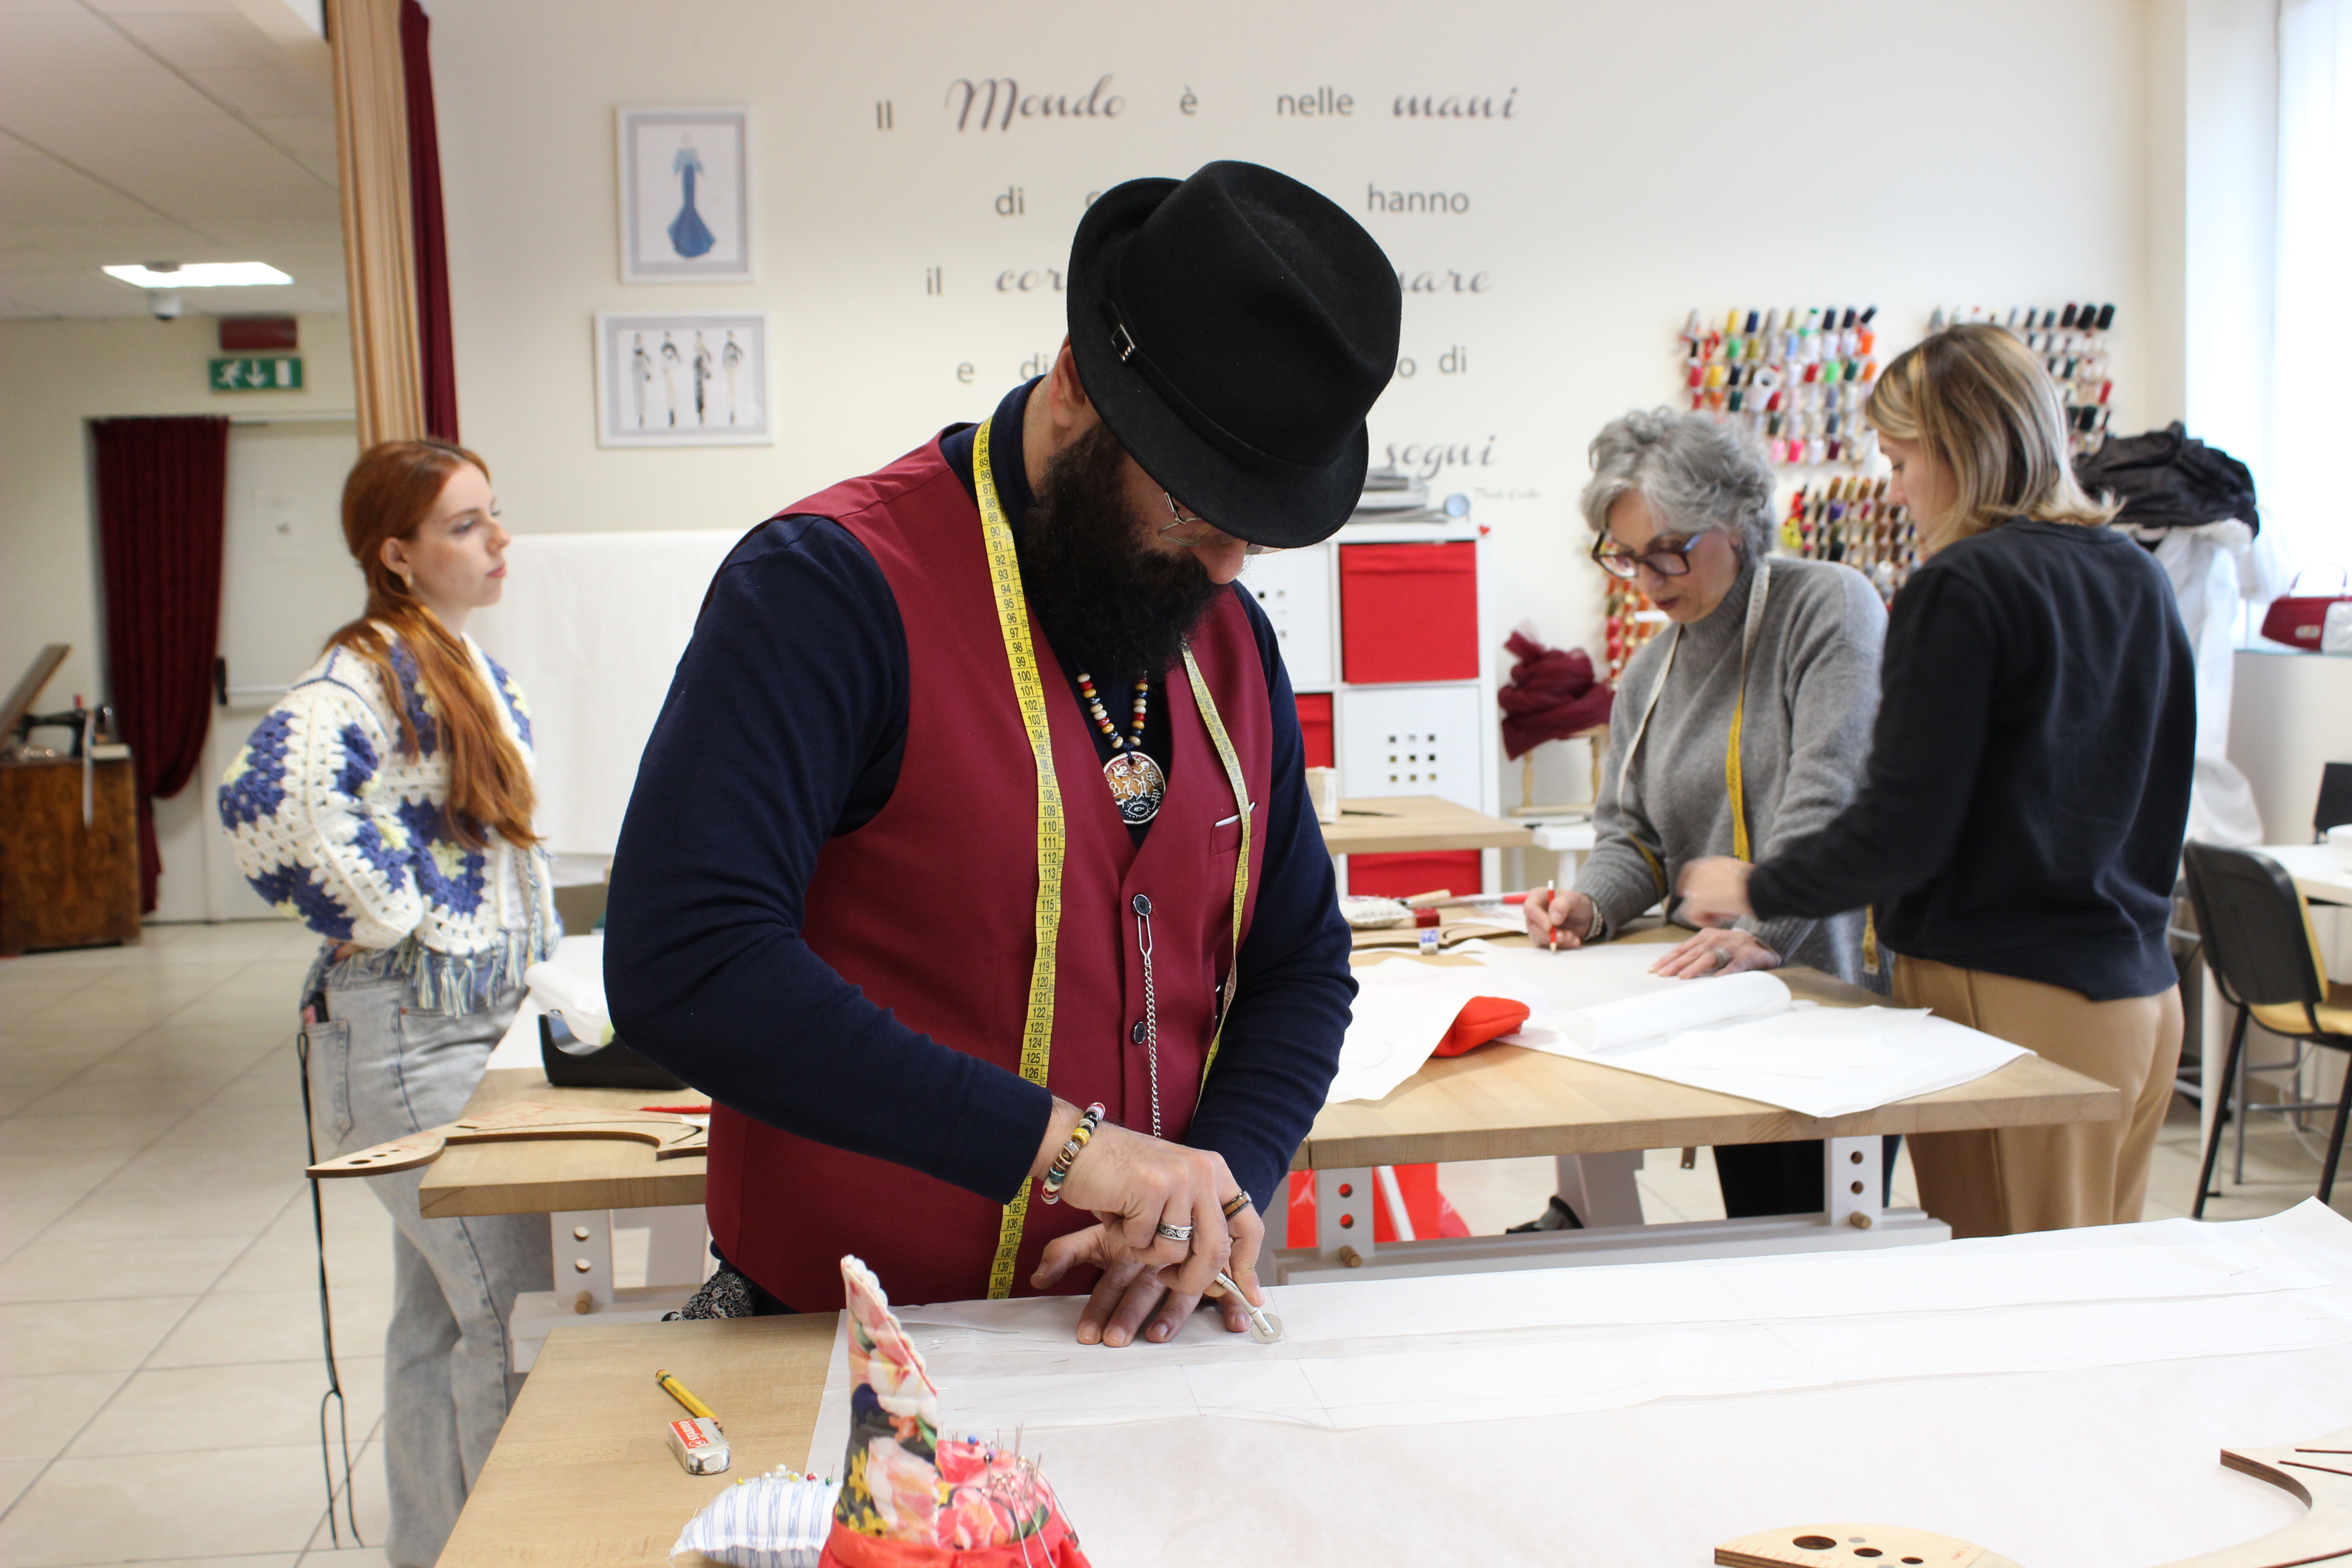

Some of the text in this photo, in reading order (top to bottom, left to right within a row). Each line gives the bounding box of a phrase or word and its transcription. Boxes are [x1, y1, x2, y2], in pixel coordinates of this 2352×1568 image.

[876, 73, 1518, 132] Il Mondo è nelle mani
[995, 181, 1470, 216] di hanno
[926, 266, 942, 295] il
[956, 362, 974, 383] e
[1439, 344, 1466, 374] di
[979, 436, 987, 445] 83
[979, 446, 987, 456] 84
[979, 457, 989, 467] 85
[1386, 433, 1496, 481] sogni
[980, 470, 990, 480] 86
[983, 483, 992, 494] 87
[985, 498, 995, 508] 88
[988, 512, 998, 522] 89
[990, 526, 1000, 537] 90
[993, 541, 1002, 551] 91
[995, 554, 1006, 565] 92
[1011, 559, 1017, 569] 46
[998, 569, 1009, 580] 93
[1001, 584, 1011, 594] 94
[1017, 589, 1023, 598] 47
[1004, 598, 1014, 609] 95
[1006, 613, 1017, 623] 96
[1022, 619, 1028, 628] 48
[1009, 627, 1019, 638] 97
[1013, 642, 1023, 652] 98
[1028, 649, 1034, 658] 49
[1016, 657, 1026, 667] 99
[1017, 671, 1031, 681] 100
[1034, 677, 1041, 686] 50
[1020, 685, 1034, 696] 101
[1024, 700, 1038, 710] 102
[1028, 715, 1041, 725] 103
[1032, 730, 1044, 740] 104
[1036, 744, 1046, 755] 105
[1039, 759, 1049, 770] 106
[1041, 774, 1051, 785] 107
[1043, 789, 1054, 800] 108
[1056, 797, 1062, 807] 54
[1043, 805, 1055, 816] 109
[1043, 821, 1057, 832] 110
[1059, 828, 1065, 838] 55
[1043, 837, 1056, 848] 111
[1043, 852, 1056, 863] 112
[1058, 860, 1063, 870] 56
[1044, 868, 1055, 879] 113
[1043, 883, 1054, 895] 114
[1042, 899, 1054, 910] 115
[1041, 915, 1053, 926] 116
[1041, 930, 1052, 941] 117
[1041, 946, 1050, 957] 118
[1039, 961, 1049, 972] 119
[1037, 976, 1049, 988] 120
[1049, 984, 1054, 993] 60
[1034, 992, 1046, 1003] 121
[1033, 1007, 1046, 1018] 122
[1031, 1022, 1044, 1033] 123
[1029, 1037, 1042, 1049] 124
[1044, 1045, 1049, 1055] 62
[1027, 1053, 1040, 1064] 125
[1024, 1068, 1039, 1079] 126
[1040, 1076, 1046, 1086] 63
[1009, 1203, 1021, 1214] 135
[1007, 1218, 1018, 1229] 136
[1004, 1233, 1015, 1244] 137
[1001, 1247, 1012, 1258] 138
[998, 1262, 1009, 1273] 139
[995, 1277, 1006, 1288] 140
[678, 1421, 700, 1441] STABILO
